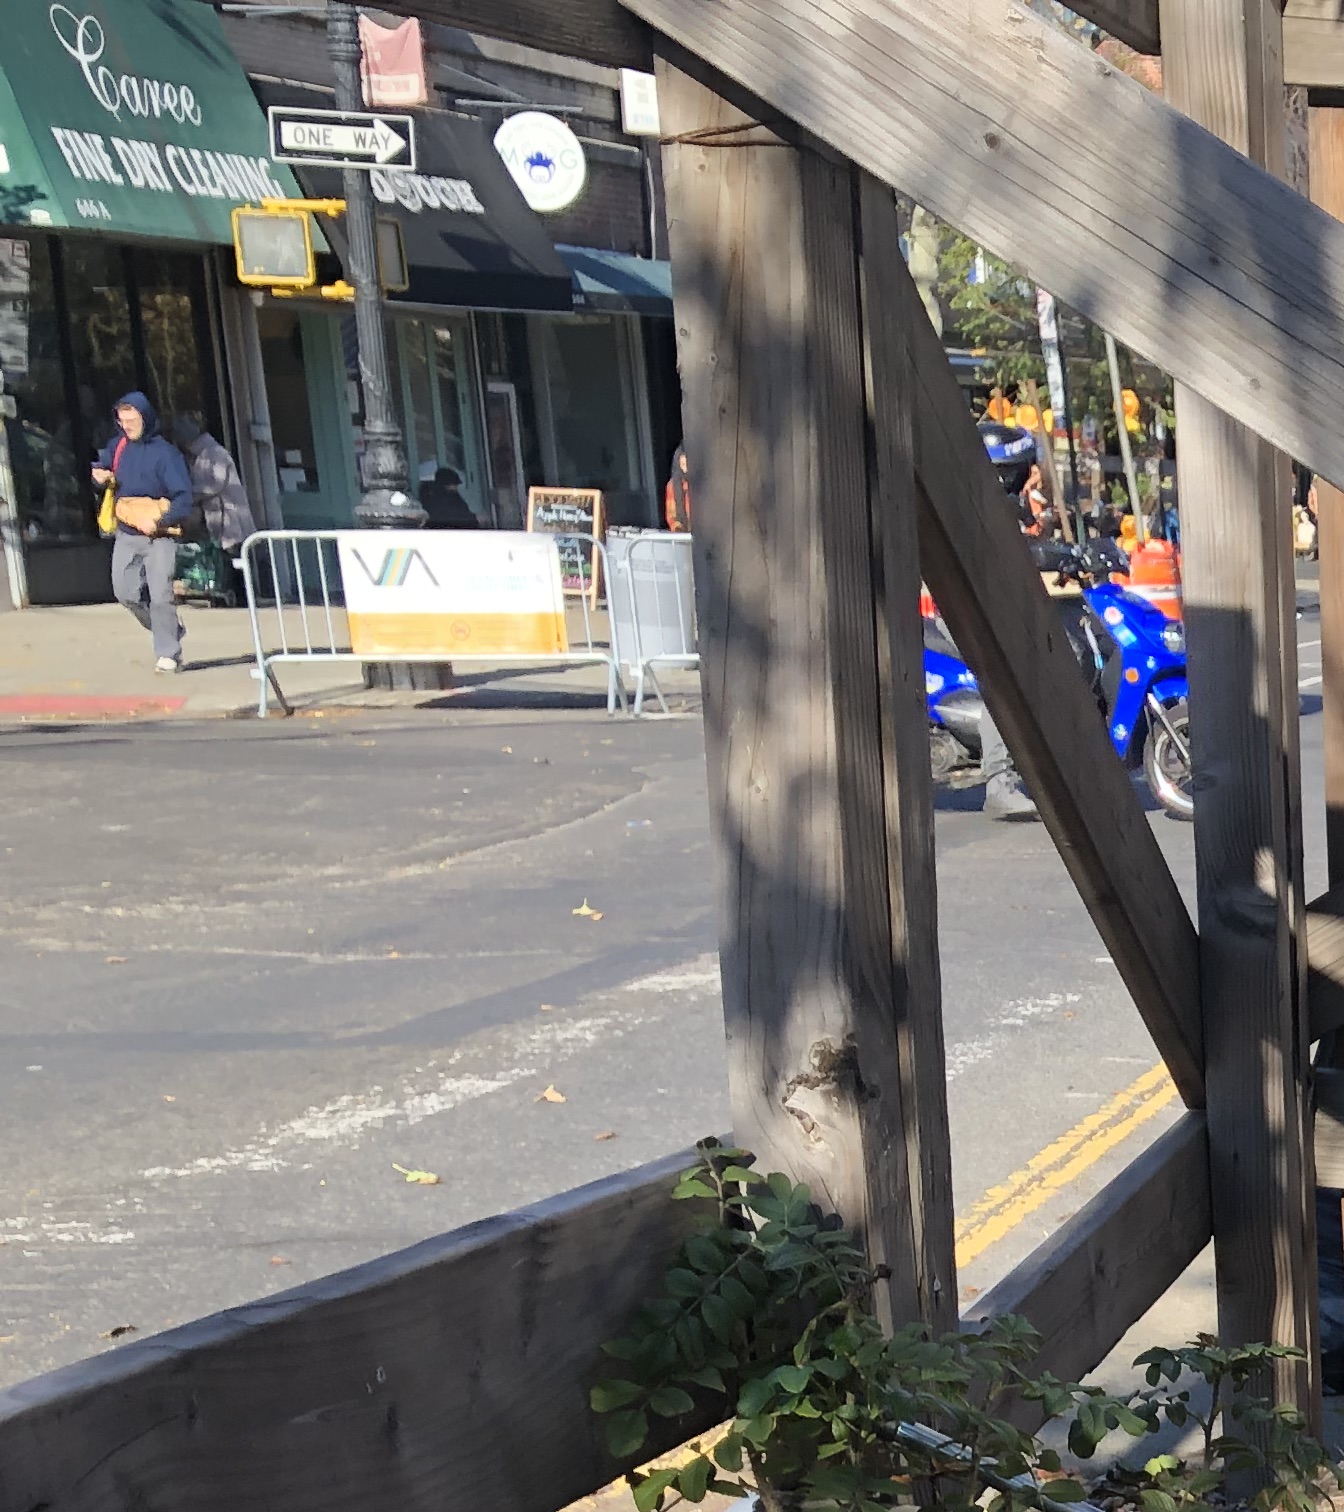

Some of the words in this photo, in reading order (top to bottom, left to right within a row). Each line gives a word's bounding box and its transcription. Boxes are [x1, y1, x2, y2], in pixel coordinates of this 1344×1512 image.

[293, 126, 334, 147] ONE
[353, 130, 392, 151] WAY
[50, 126, 124, 186] FINE
[109, 136, 173, 193] DRY
[165, 144, 286, 202] CLEANING
